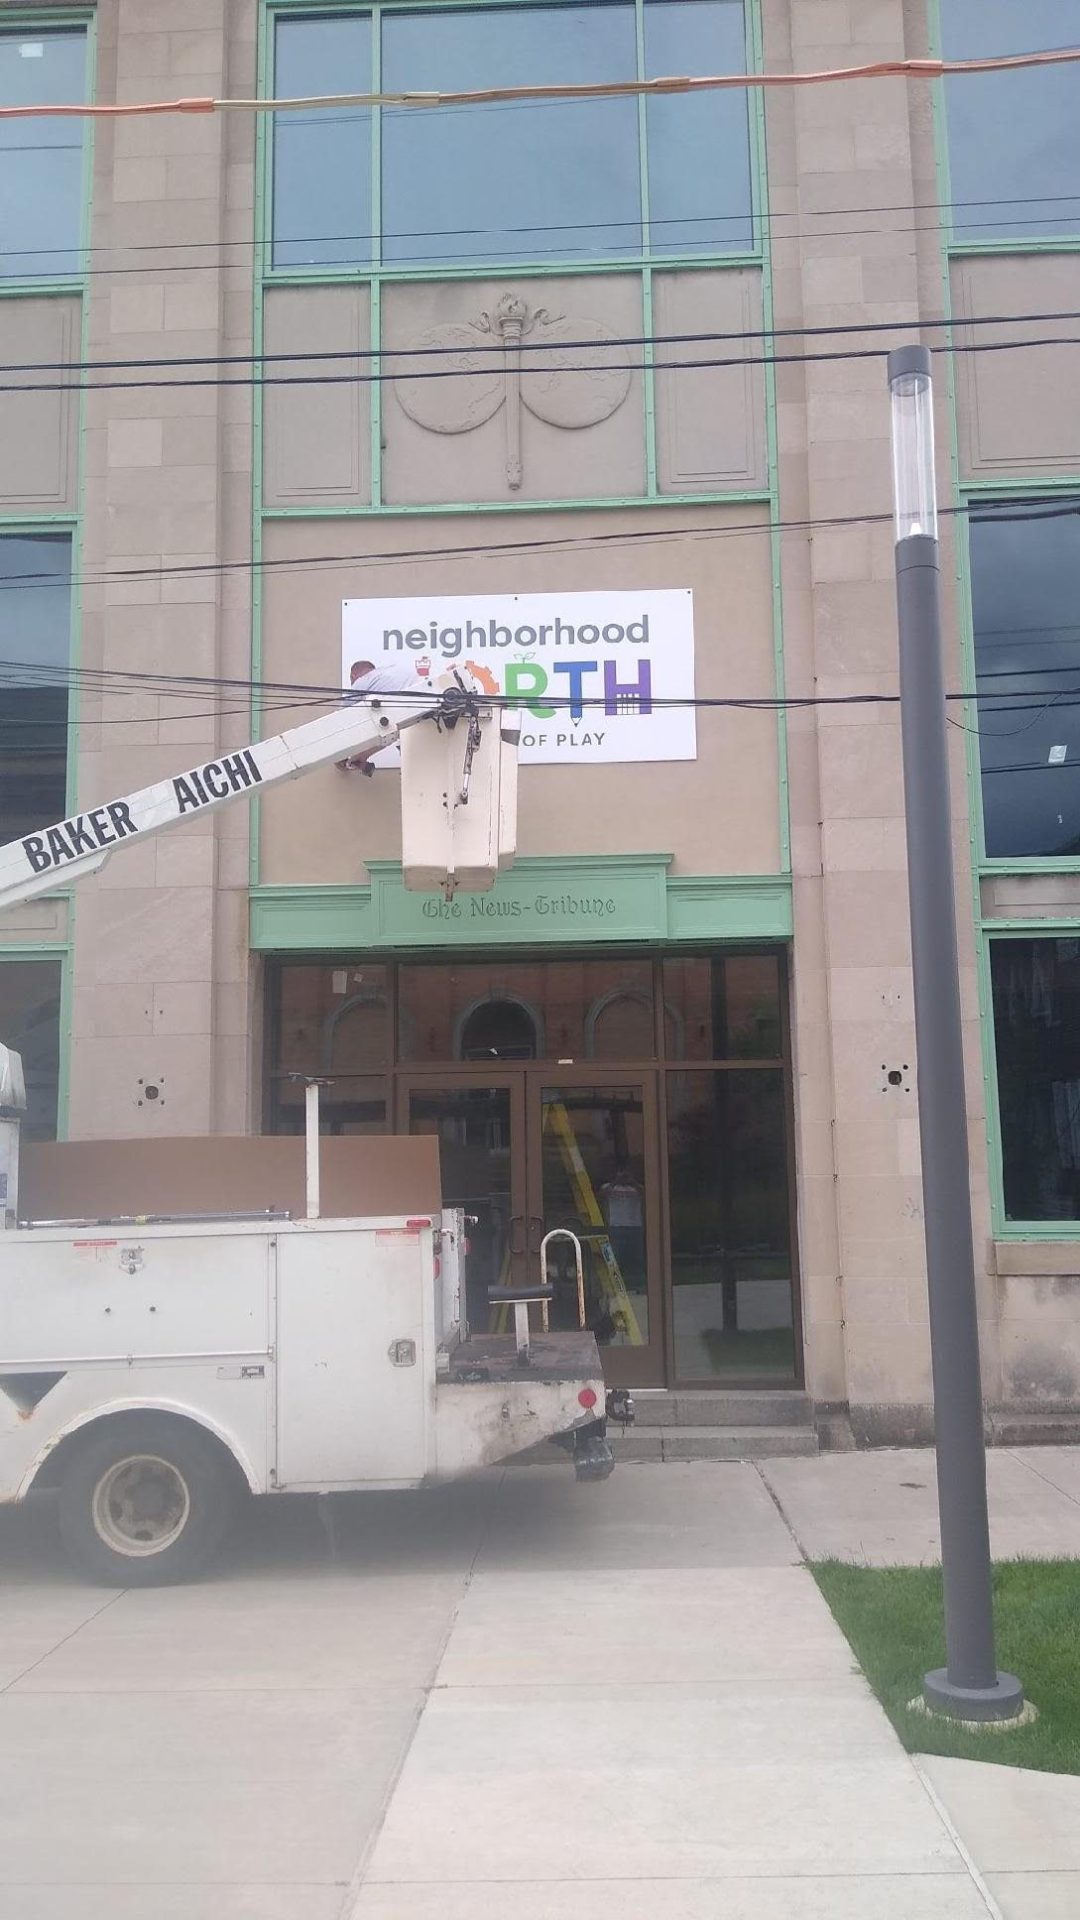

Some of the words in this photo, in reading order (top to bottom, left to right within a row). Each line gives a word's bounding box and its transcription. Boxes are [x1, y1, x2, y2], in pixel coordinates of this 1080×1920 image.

[382, 614, 649, 658] neighborhood
[522, 734, 547, 748] OF
[556, 732, 606, 747] PLAY
[21, 801, 139, 873] BAKER
[172, 749, 263, 814] AICHI
[422, 897, 462, 919] The
[470, 895, 616, 917] News-Tribune
